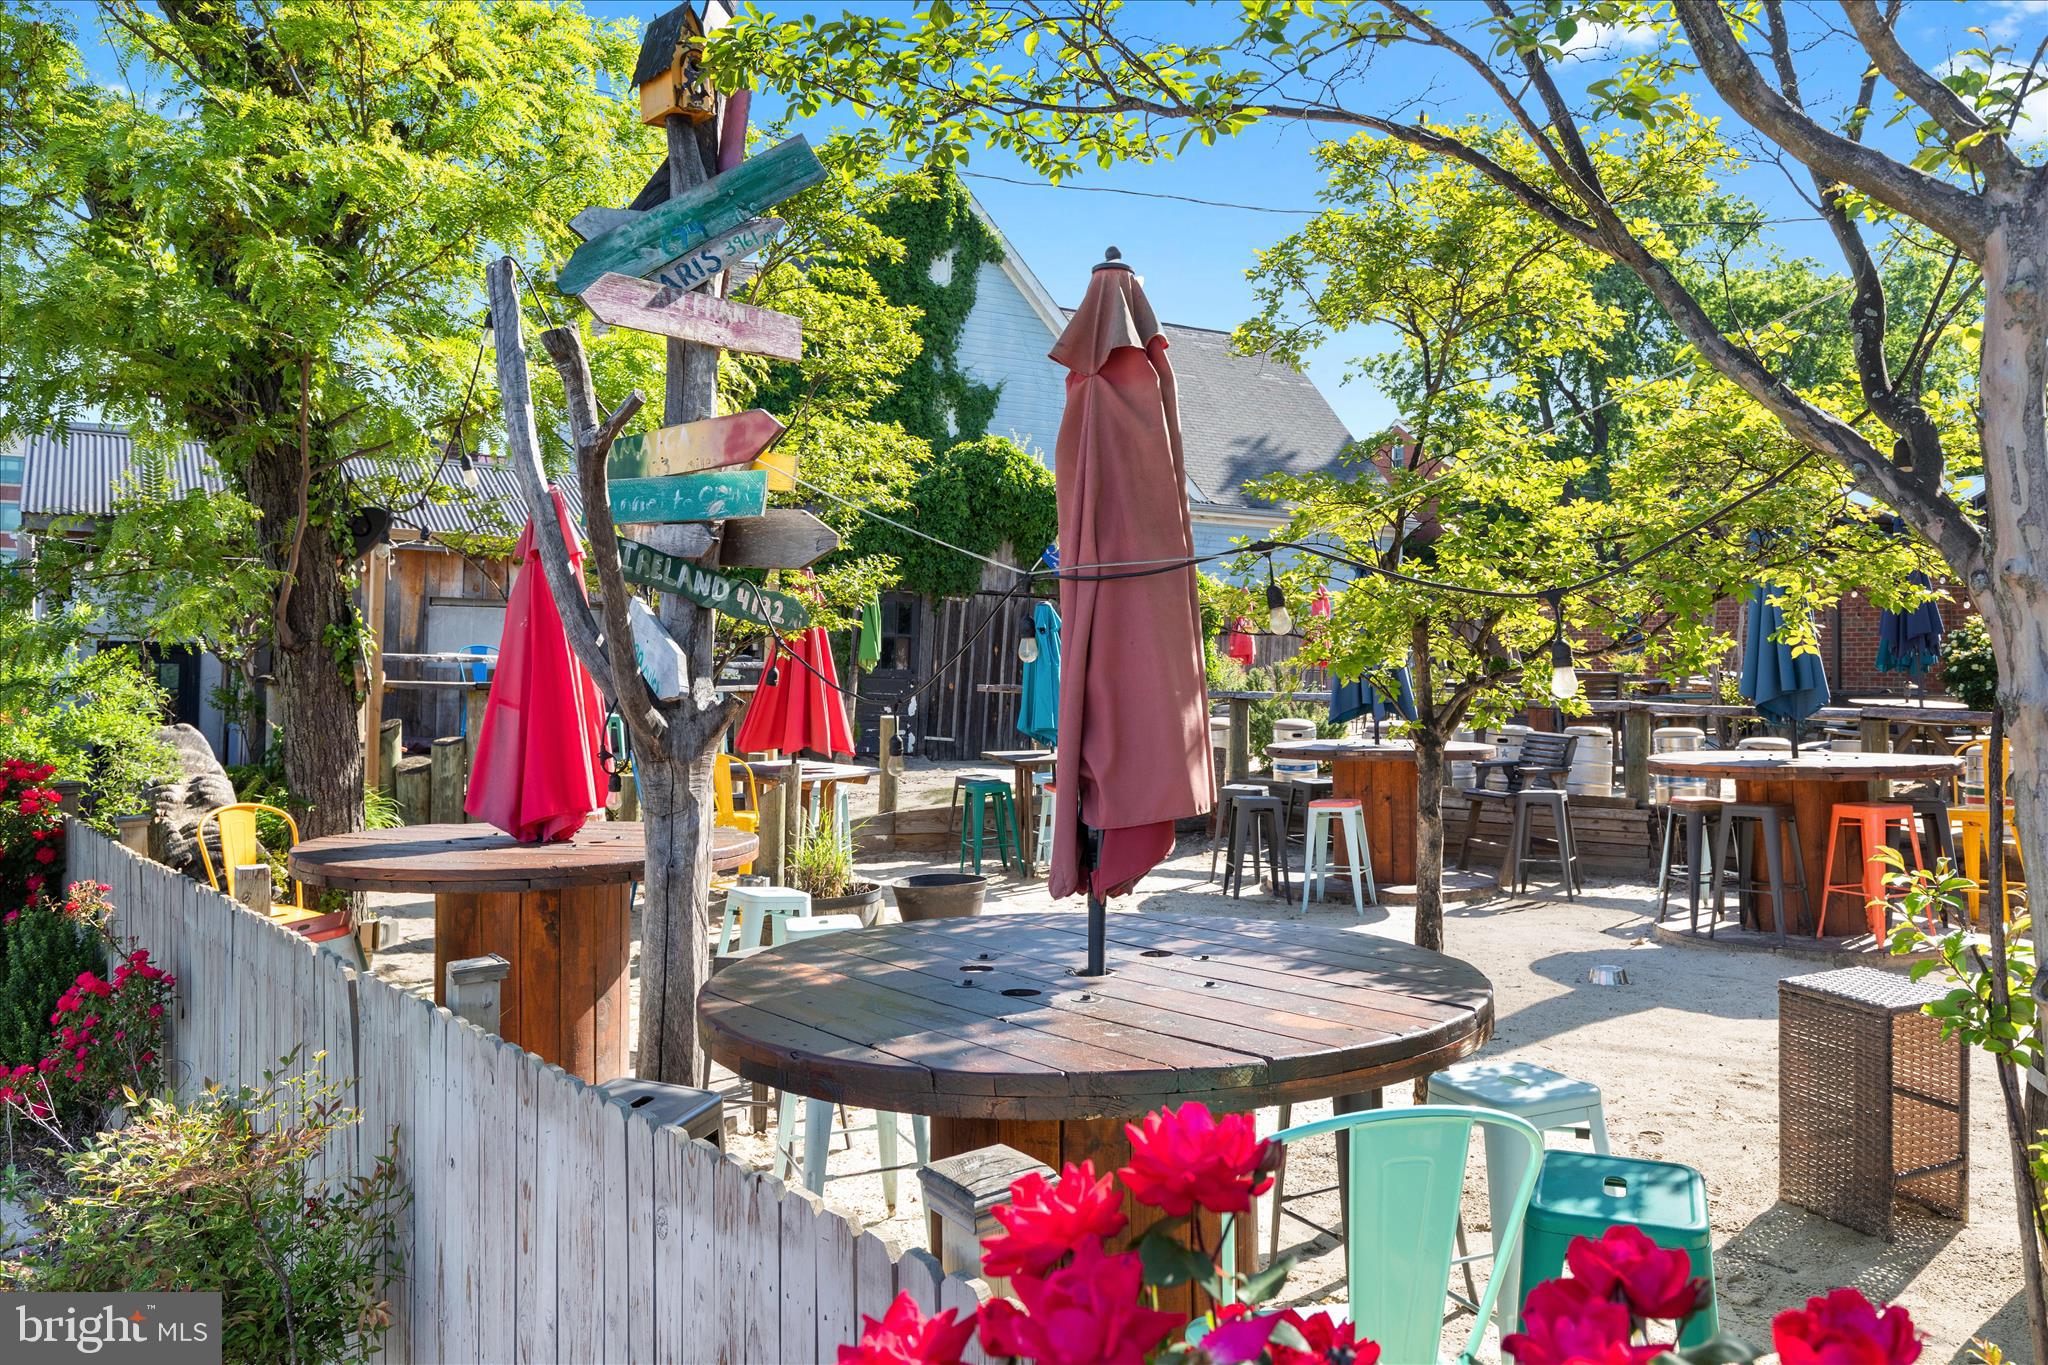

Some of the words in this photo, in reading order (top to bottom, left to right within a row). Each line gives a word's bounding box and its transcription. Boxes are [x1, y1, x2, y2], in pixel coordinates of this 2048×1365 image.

[660, 251, 722, 290] ARIS
[621, 540, 731, 602] IRELAND
[736, 587, 785, 625] 4182
